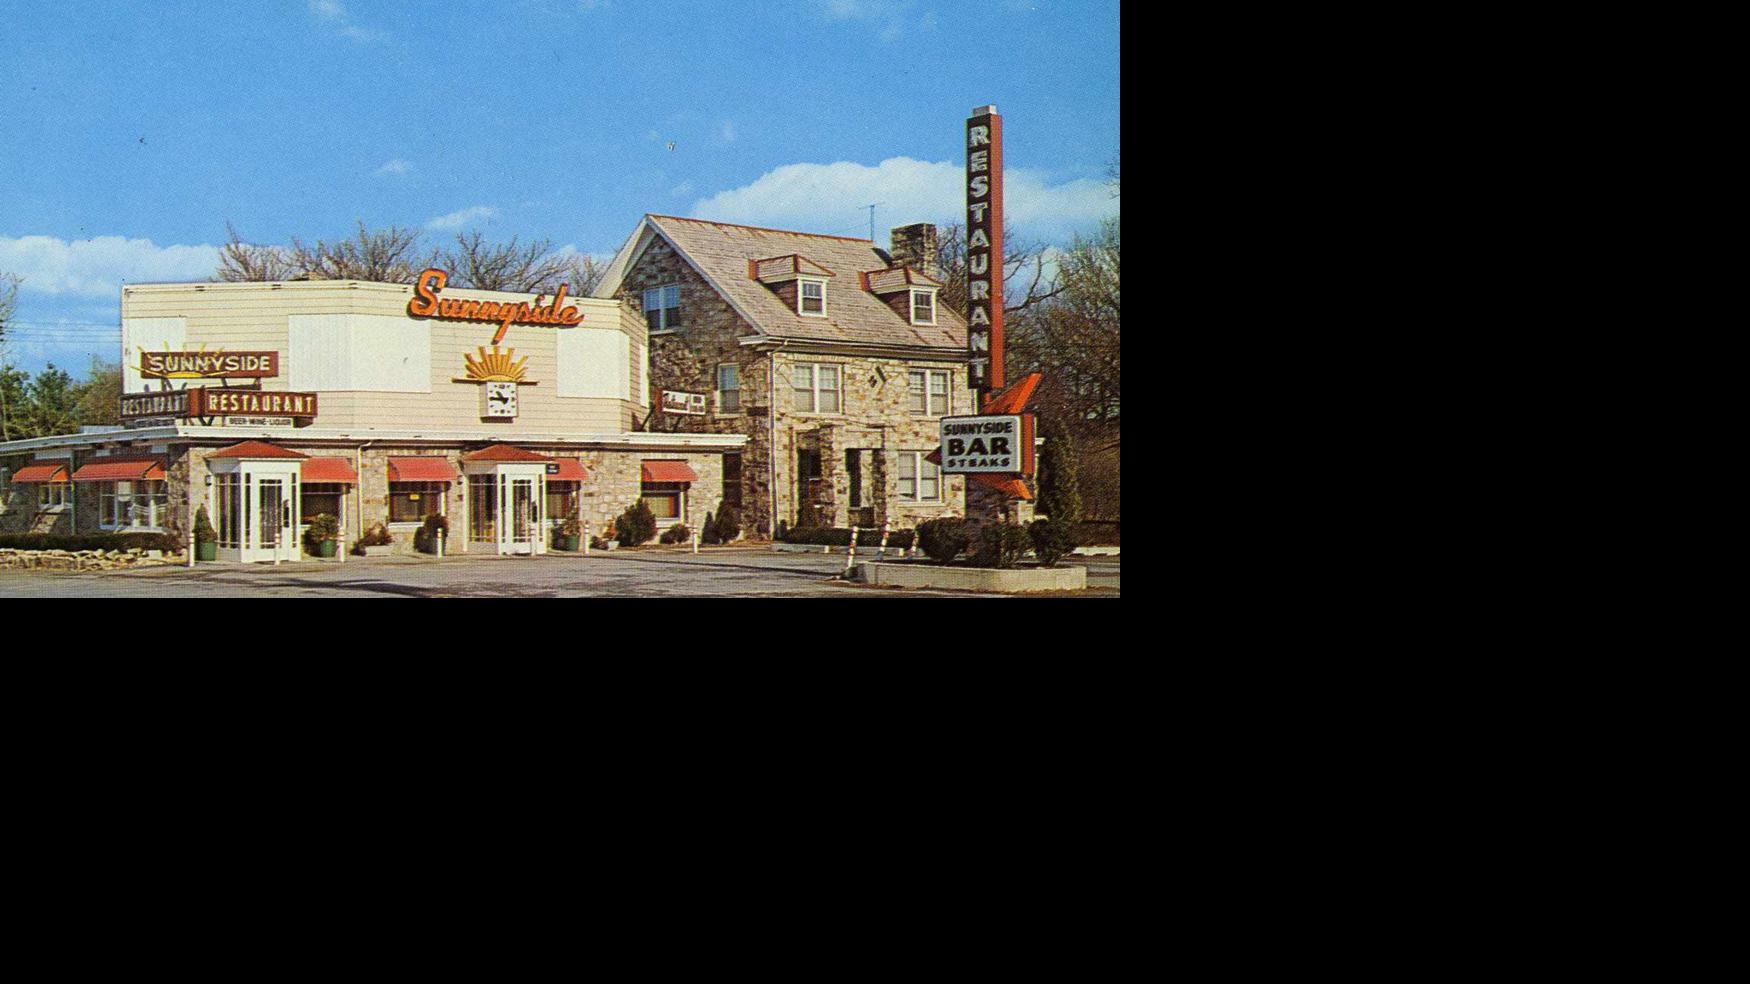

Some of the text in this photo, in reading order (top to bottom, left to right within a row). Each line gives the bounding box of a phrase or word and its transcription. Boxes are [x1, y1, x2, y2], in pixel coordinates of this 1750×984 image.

[969, 125, 990, 379] RESTAURANT
[408, 268, 585, 344] Sunnyside
[150, 355, 270, 371] SUNNYSIDE
[209, 394, 313, 413] RESTAURANT
[944, 422, 1012, 435] SUNNYSIDE
[948, 437, 1011, 455] BAR
[947, 458, 1009, 467] STEAKS
